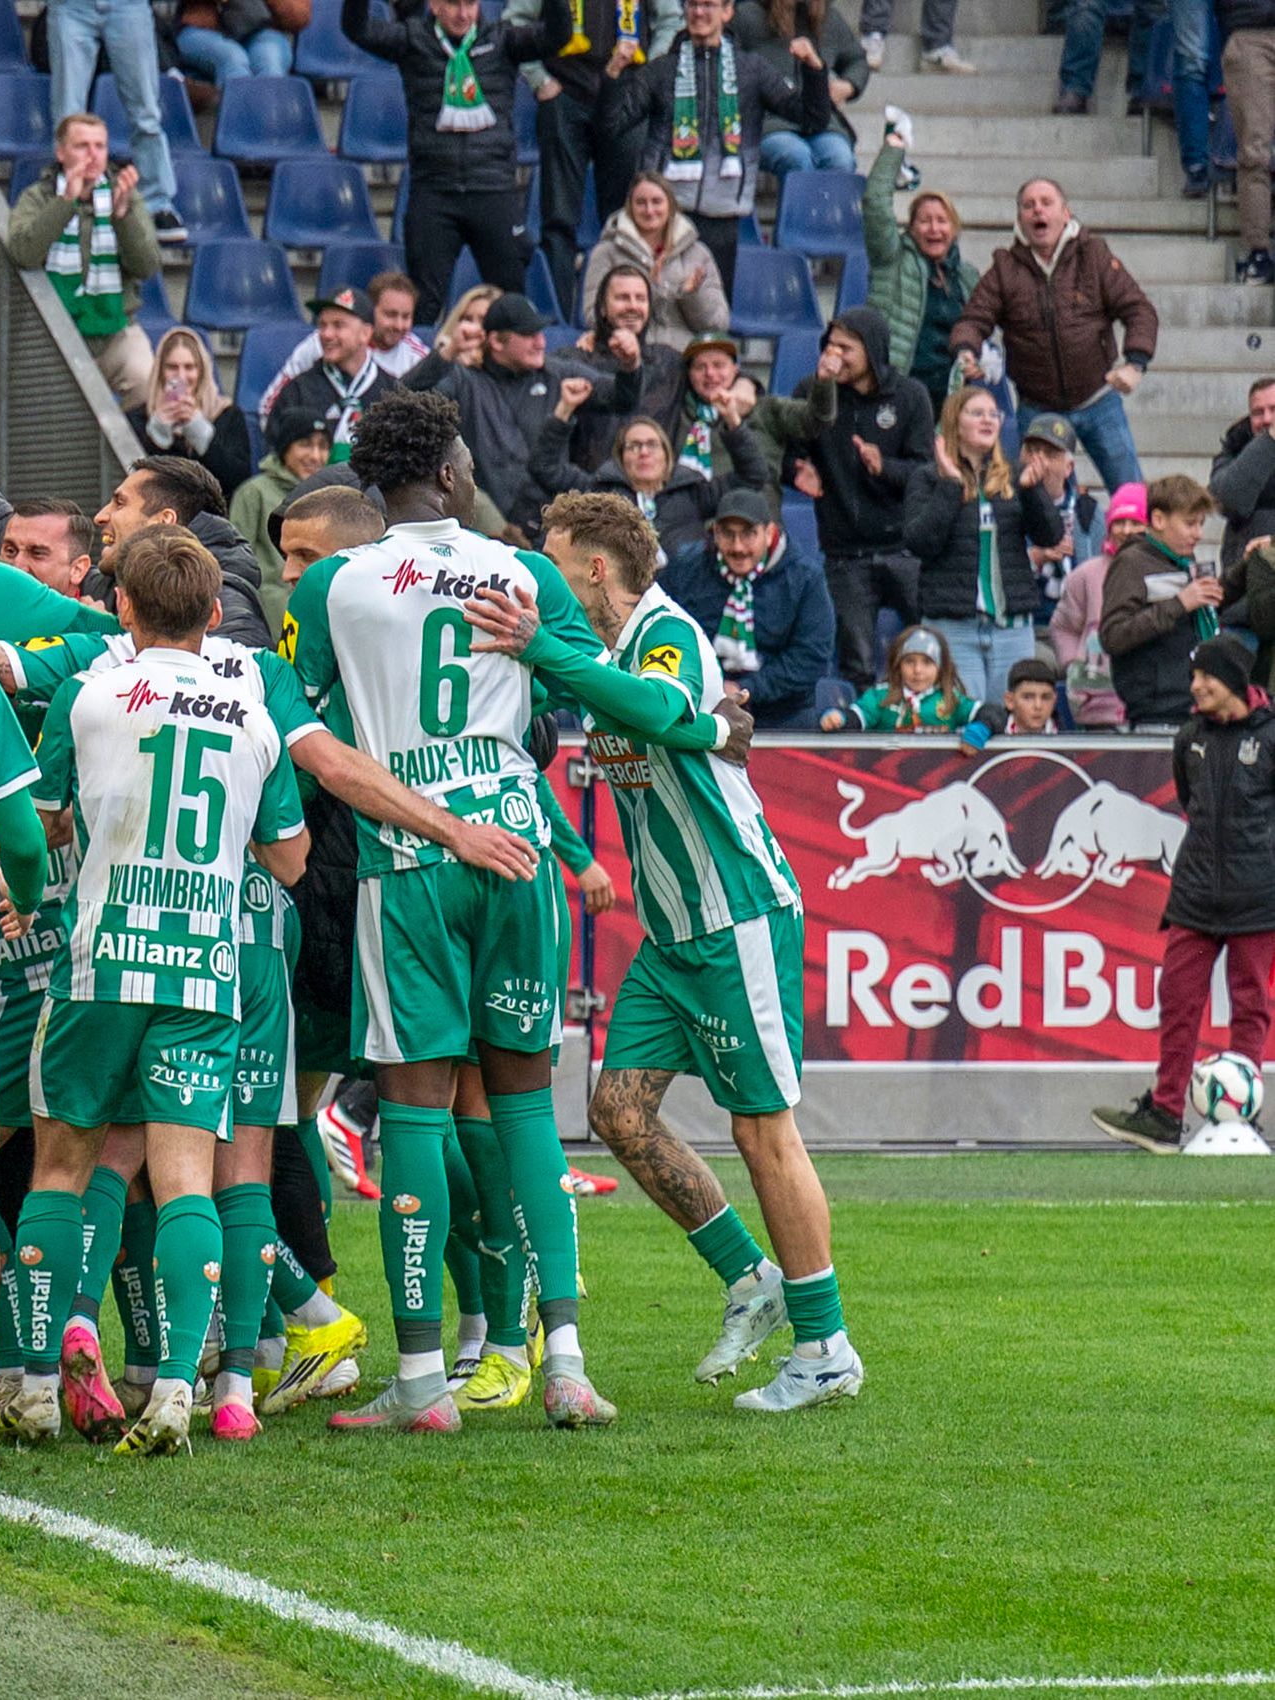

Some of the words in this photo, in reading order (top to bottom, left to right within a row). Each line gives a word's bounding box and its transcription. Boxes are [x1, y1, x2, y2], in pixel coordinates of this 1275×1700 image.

[432, 569, 511, 601] köck
[203, 655, 244, 678] ck
[419, 607, 473, 737] 6
[168, 691, 249, 728] köck
[139, 724, 233, 865] 15
[95, 931, 203, 970] Allianz
[826, 926, 1023, 1030] Red
[1042, 930, 1233, 1030] Bul
[159, 1047, 215, 1069] WIENER
[239, 1047, 275, 1066] ENER
[149, 1064, 222, 1090] ZUCKER
[236, 1070, 279, 1084] CKER
[403, 1217, 431, 1310] easystaff
[29, 1269, 53, 1351] easystaff
[121, 1265, 151, 1348] easystaff
